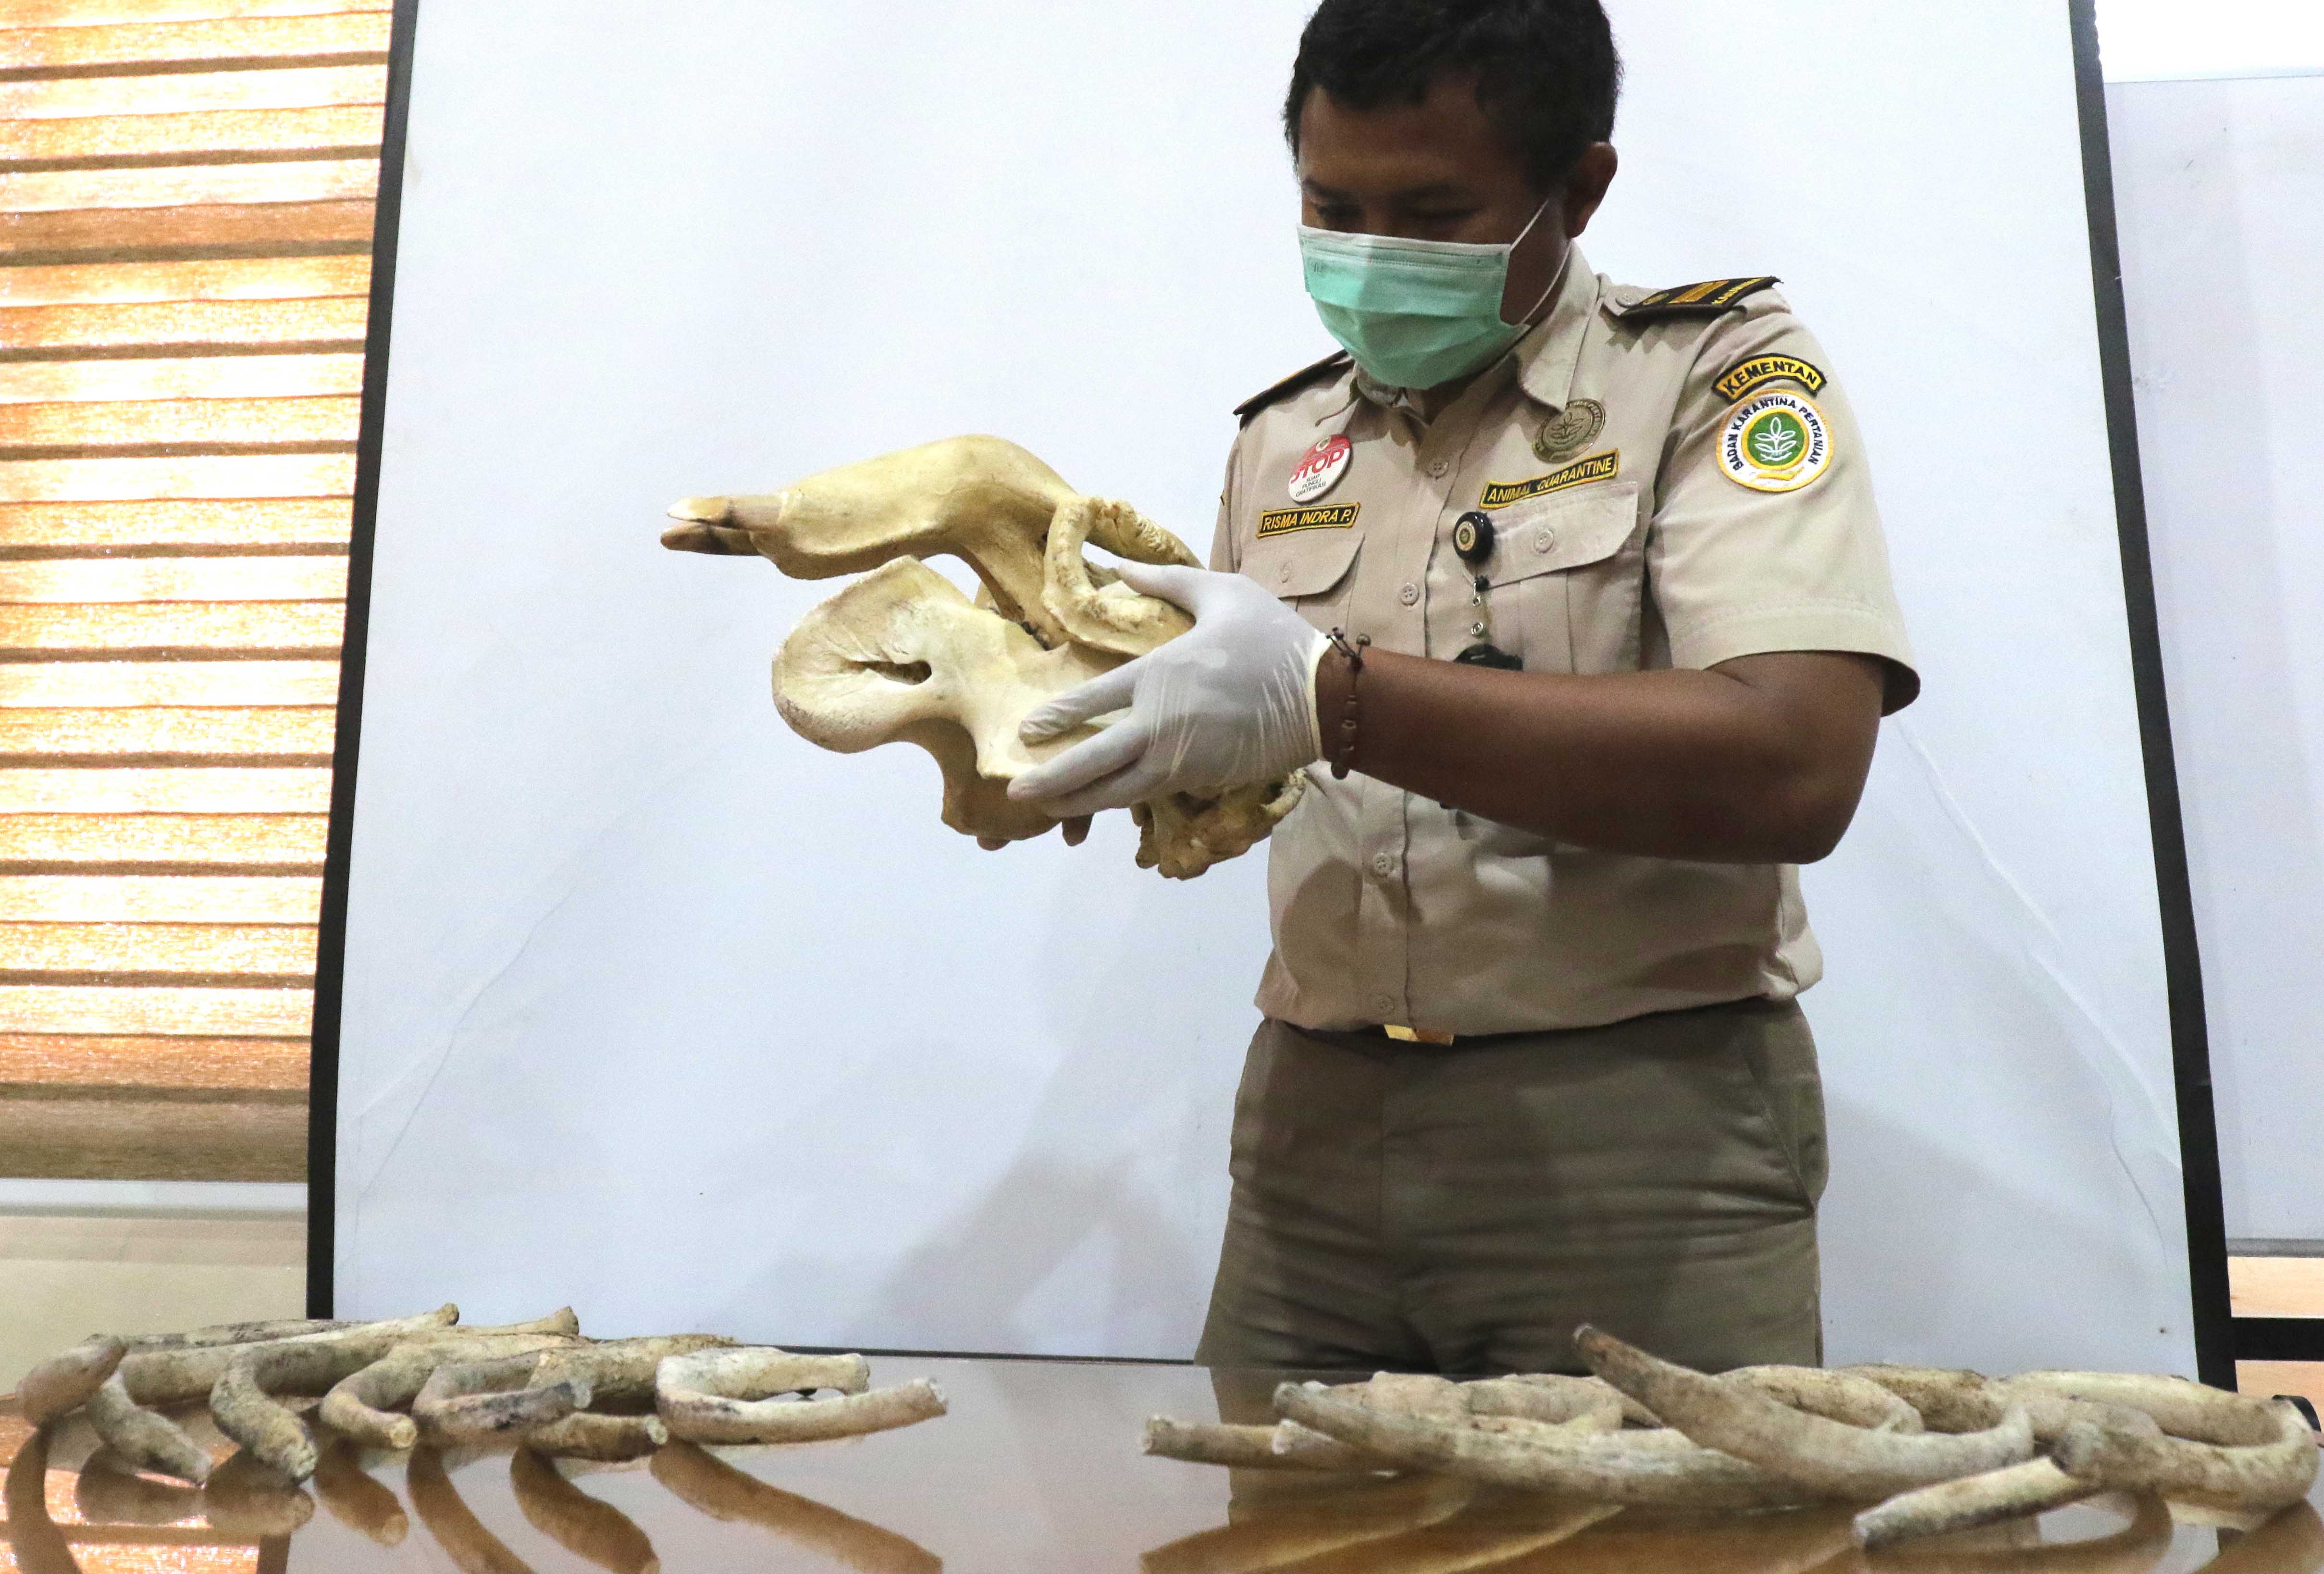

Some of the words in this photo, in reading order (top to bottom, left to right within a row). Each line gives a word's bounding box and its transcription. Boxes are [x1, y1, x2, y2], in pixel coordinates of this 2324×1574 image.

[1722, 360, 1817, 395] KEMENTAN
[1731, 397, 1796, 431] KARANTINA
[1727, 434, 1744, 471] BADAN
[1799, 407, 1823, 465] PERTANIAN
[1290, 447, 1345, 484] STOP
[1487, 482, 1531, 502] ANIMAL
[1537, 457, 1613, 491] QUARANTINE
[1263, 513, 1298, 531] RISMA
[1299, 509, 1338, 524] INDRA
[1340, 509, 1352, 521] P.
